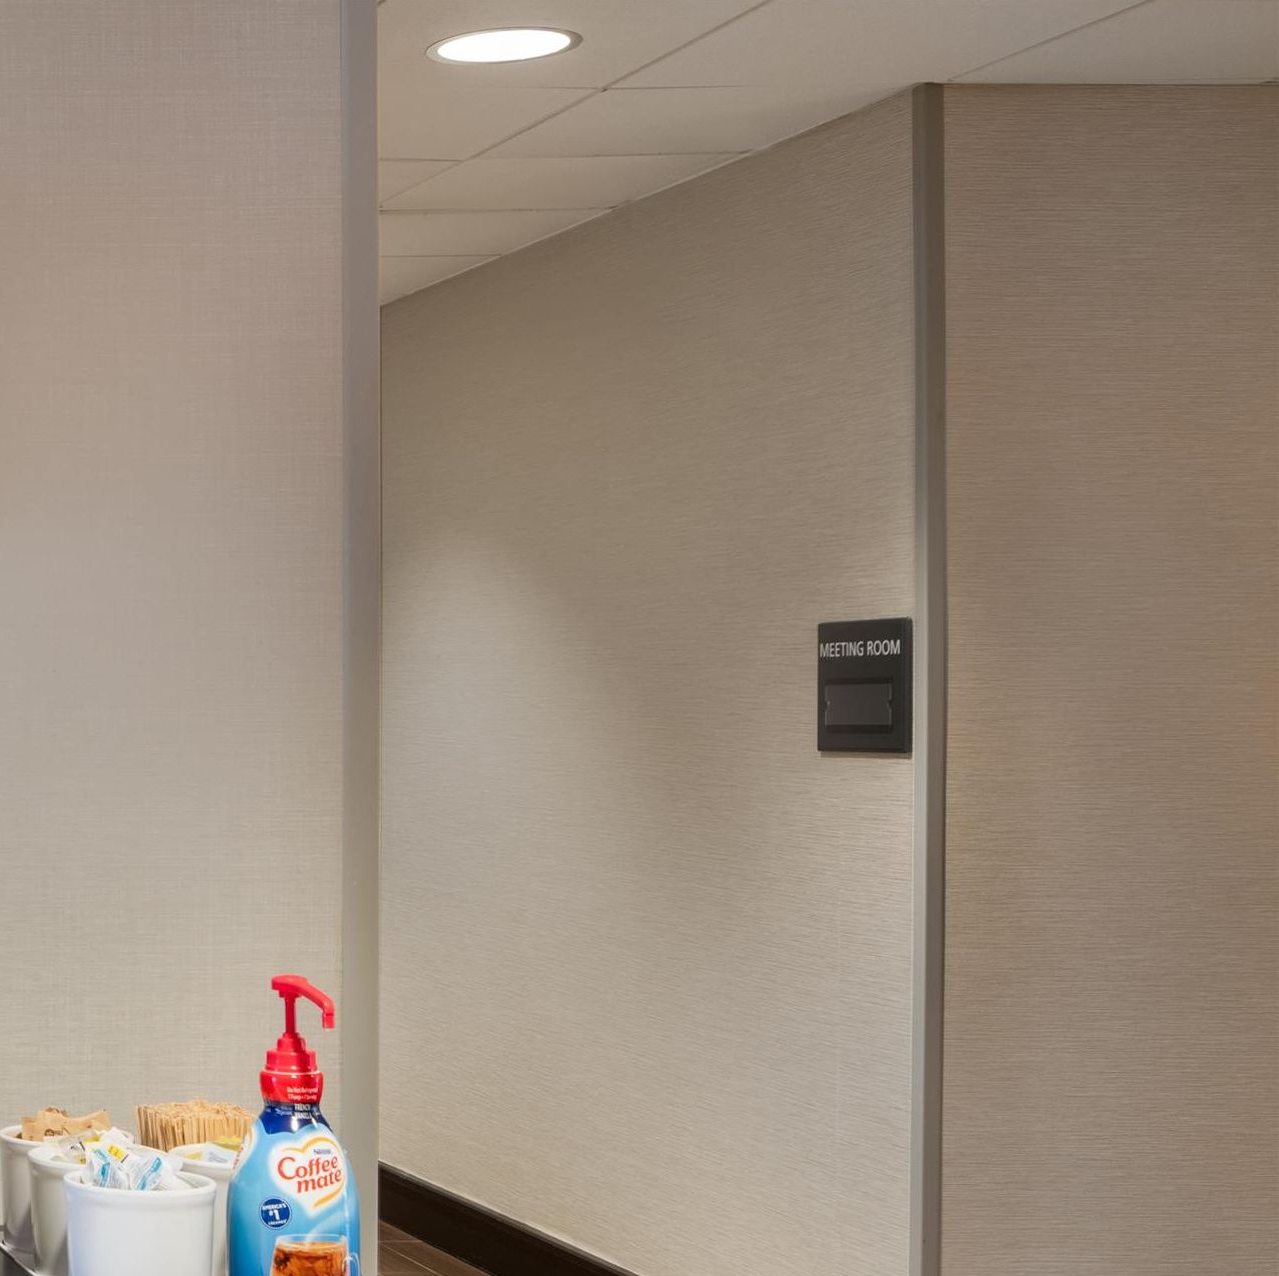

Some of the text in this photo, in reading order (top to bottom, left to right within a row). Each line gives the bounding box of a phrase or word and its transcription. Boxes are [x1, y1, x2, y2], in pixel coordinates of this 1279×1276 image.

[819, 639, 901, 658] MEETING ROOM
[277, 1156, 338, 1181] Coffee
[297, 1169, 342, 1194] mate
